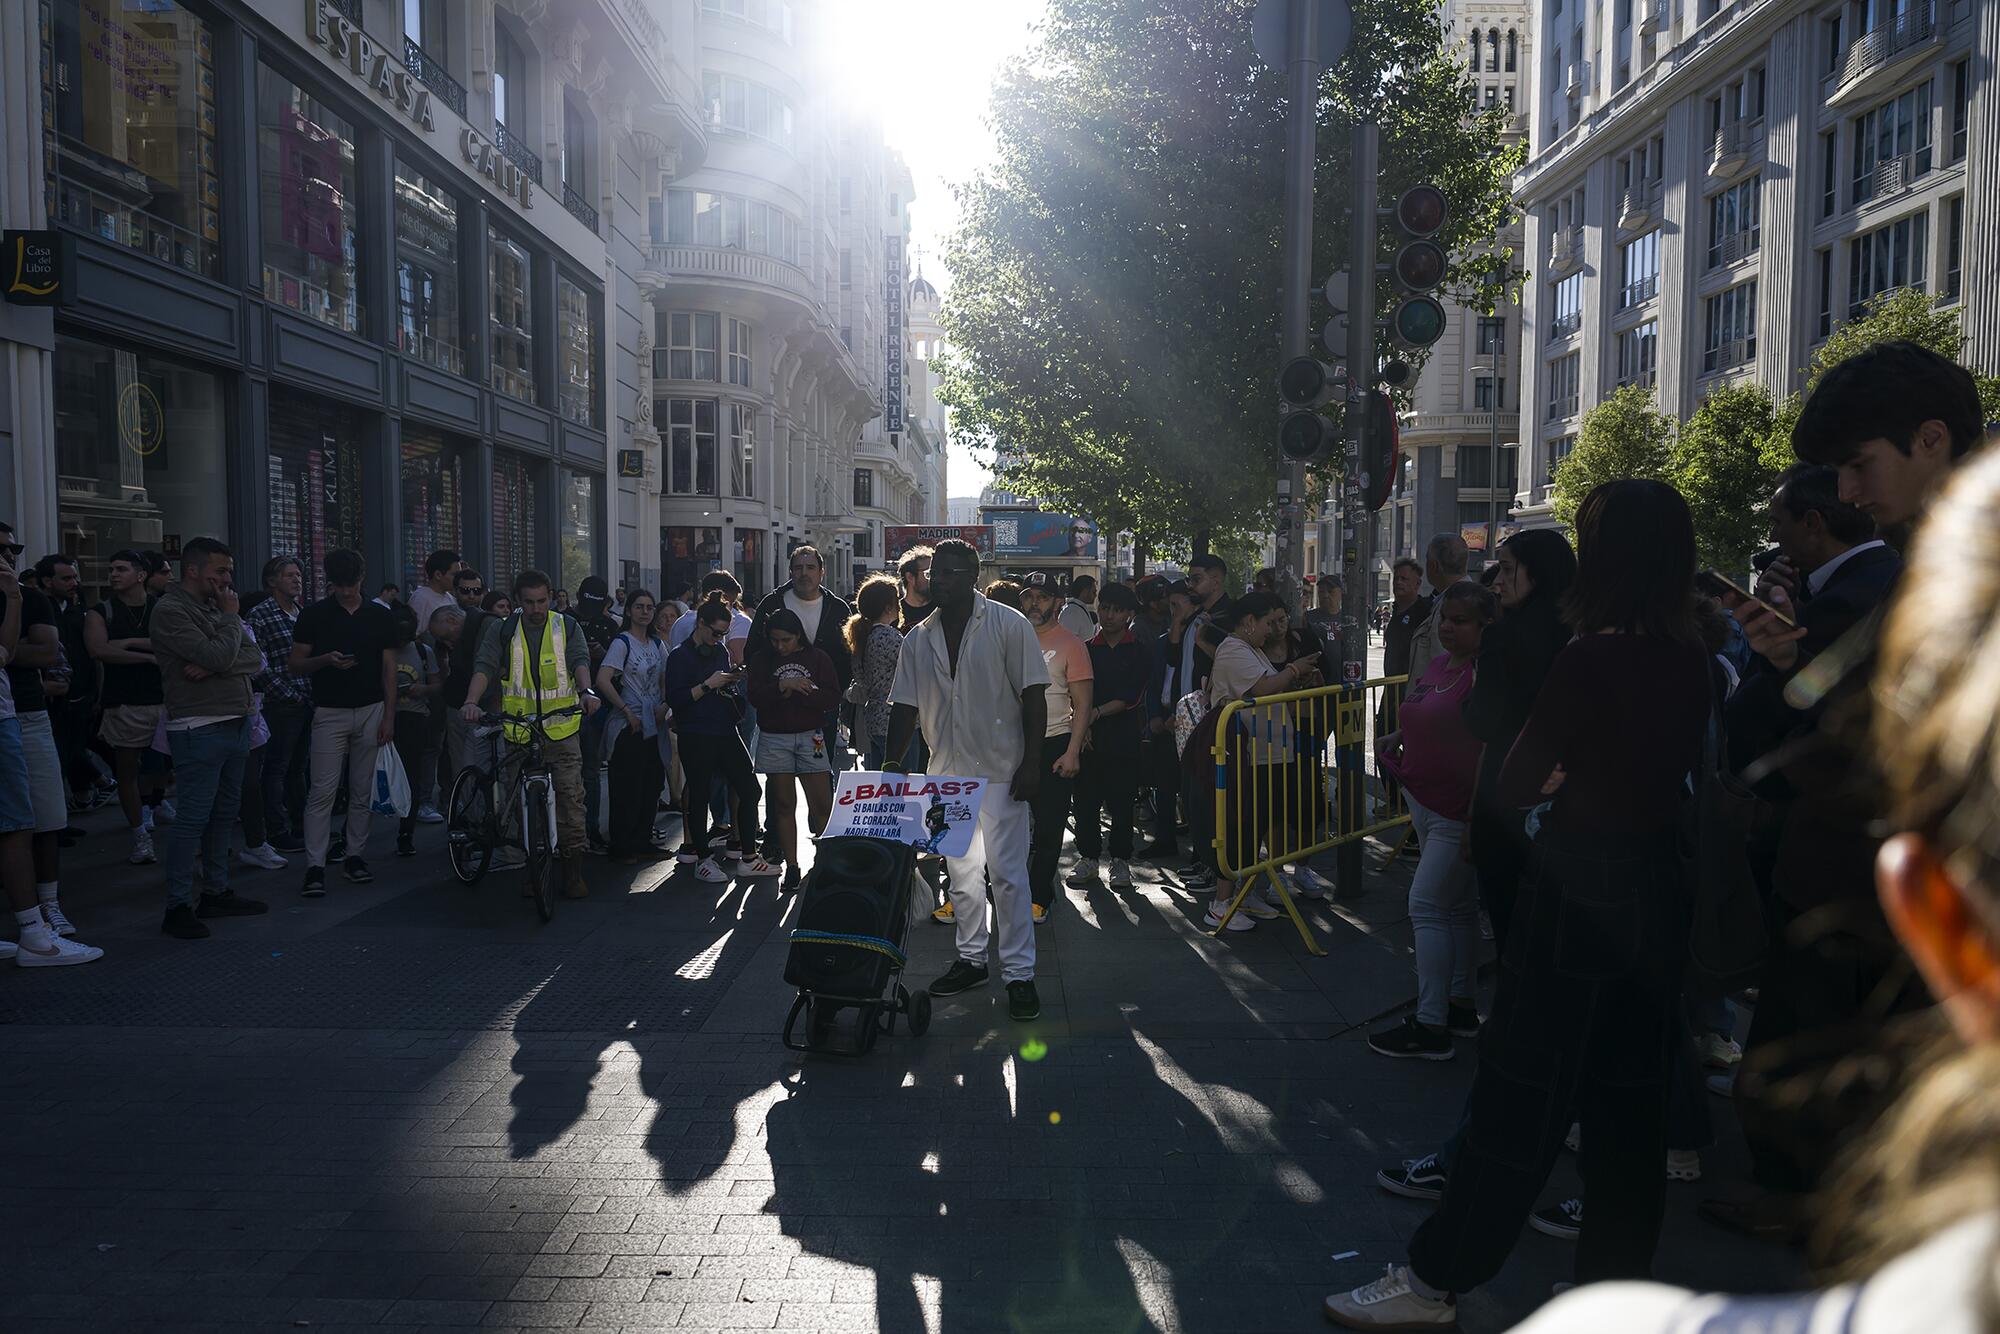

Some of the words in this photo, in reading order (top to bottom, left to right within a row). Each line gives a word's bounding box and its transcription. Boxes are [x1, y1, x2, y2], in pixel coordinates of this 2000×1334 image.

[305, 0, 435, 133] ESPASA
[460, 127, 533, 210] CALPE
[26, 244, 51, 256] Casa
[38, 255, 52, 264] del
[26, 263, 52, 273] Libro
[887, 259, 900, 328] HOTEL
[887, 333, 901, 429] REGENTE
[322, 431, 337, 504] KLIMT
[341, 440, 352, 551] VELAZQUE
[918, 527, 961, 539] MADRID
[838, 781, 980, 806] ¿BAILAS?
[853, 802, 862, 813] SI
[862, 802, 889, 814] BAILAS
[889, 803, 906, 814] CON
[852, 815, 861, 826] EL
[862, 814, 899, 827] CORAZÓN,
[844, 827, 868, 836] NADIE
